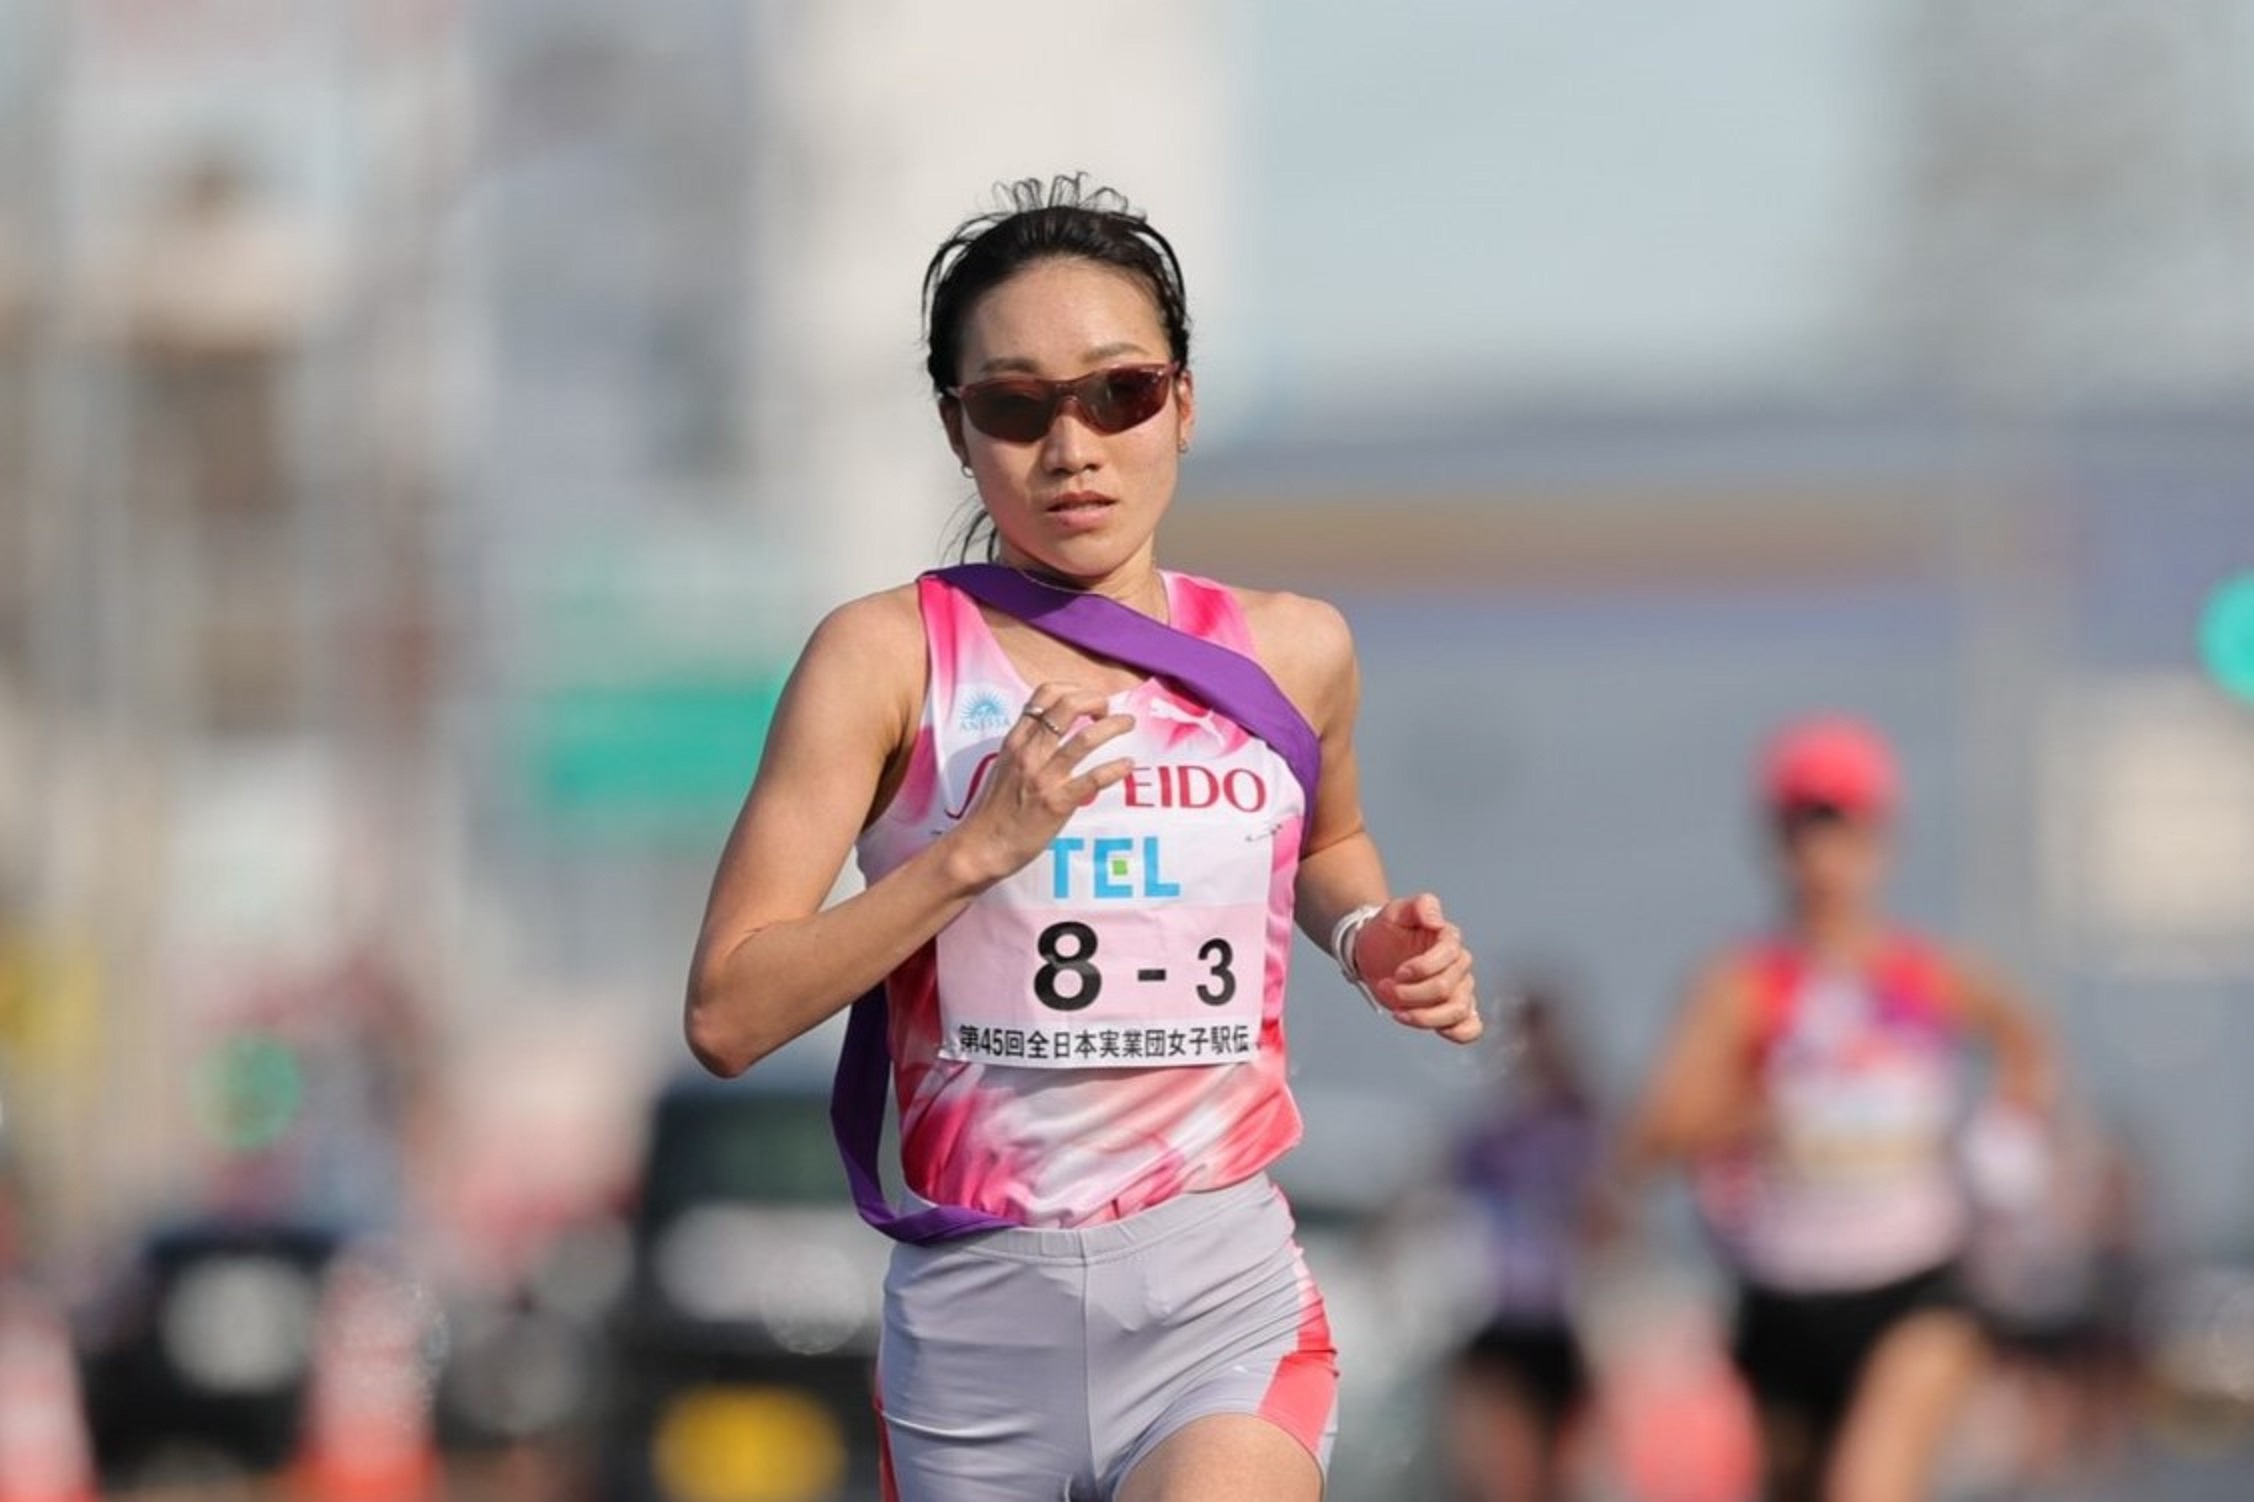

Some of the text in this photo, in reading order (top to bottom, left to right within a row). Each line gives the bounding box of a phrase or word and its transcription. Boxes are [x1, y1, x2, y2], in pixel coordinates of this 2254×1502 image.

[1047, 836, 1181, 899] TEL
[959, 1025, 1250, 1059] 第45回全日本実業団女子駅伝
